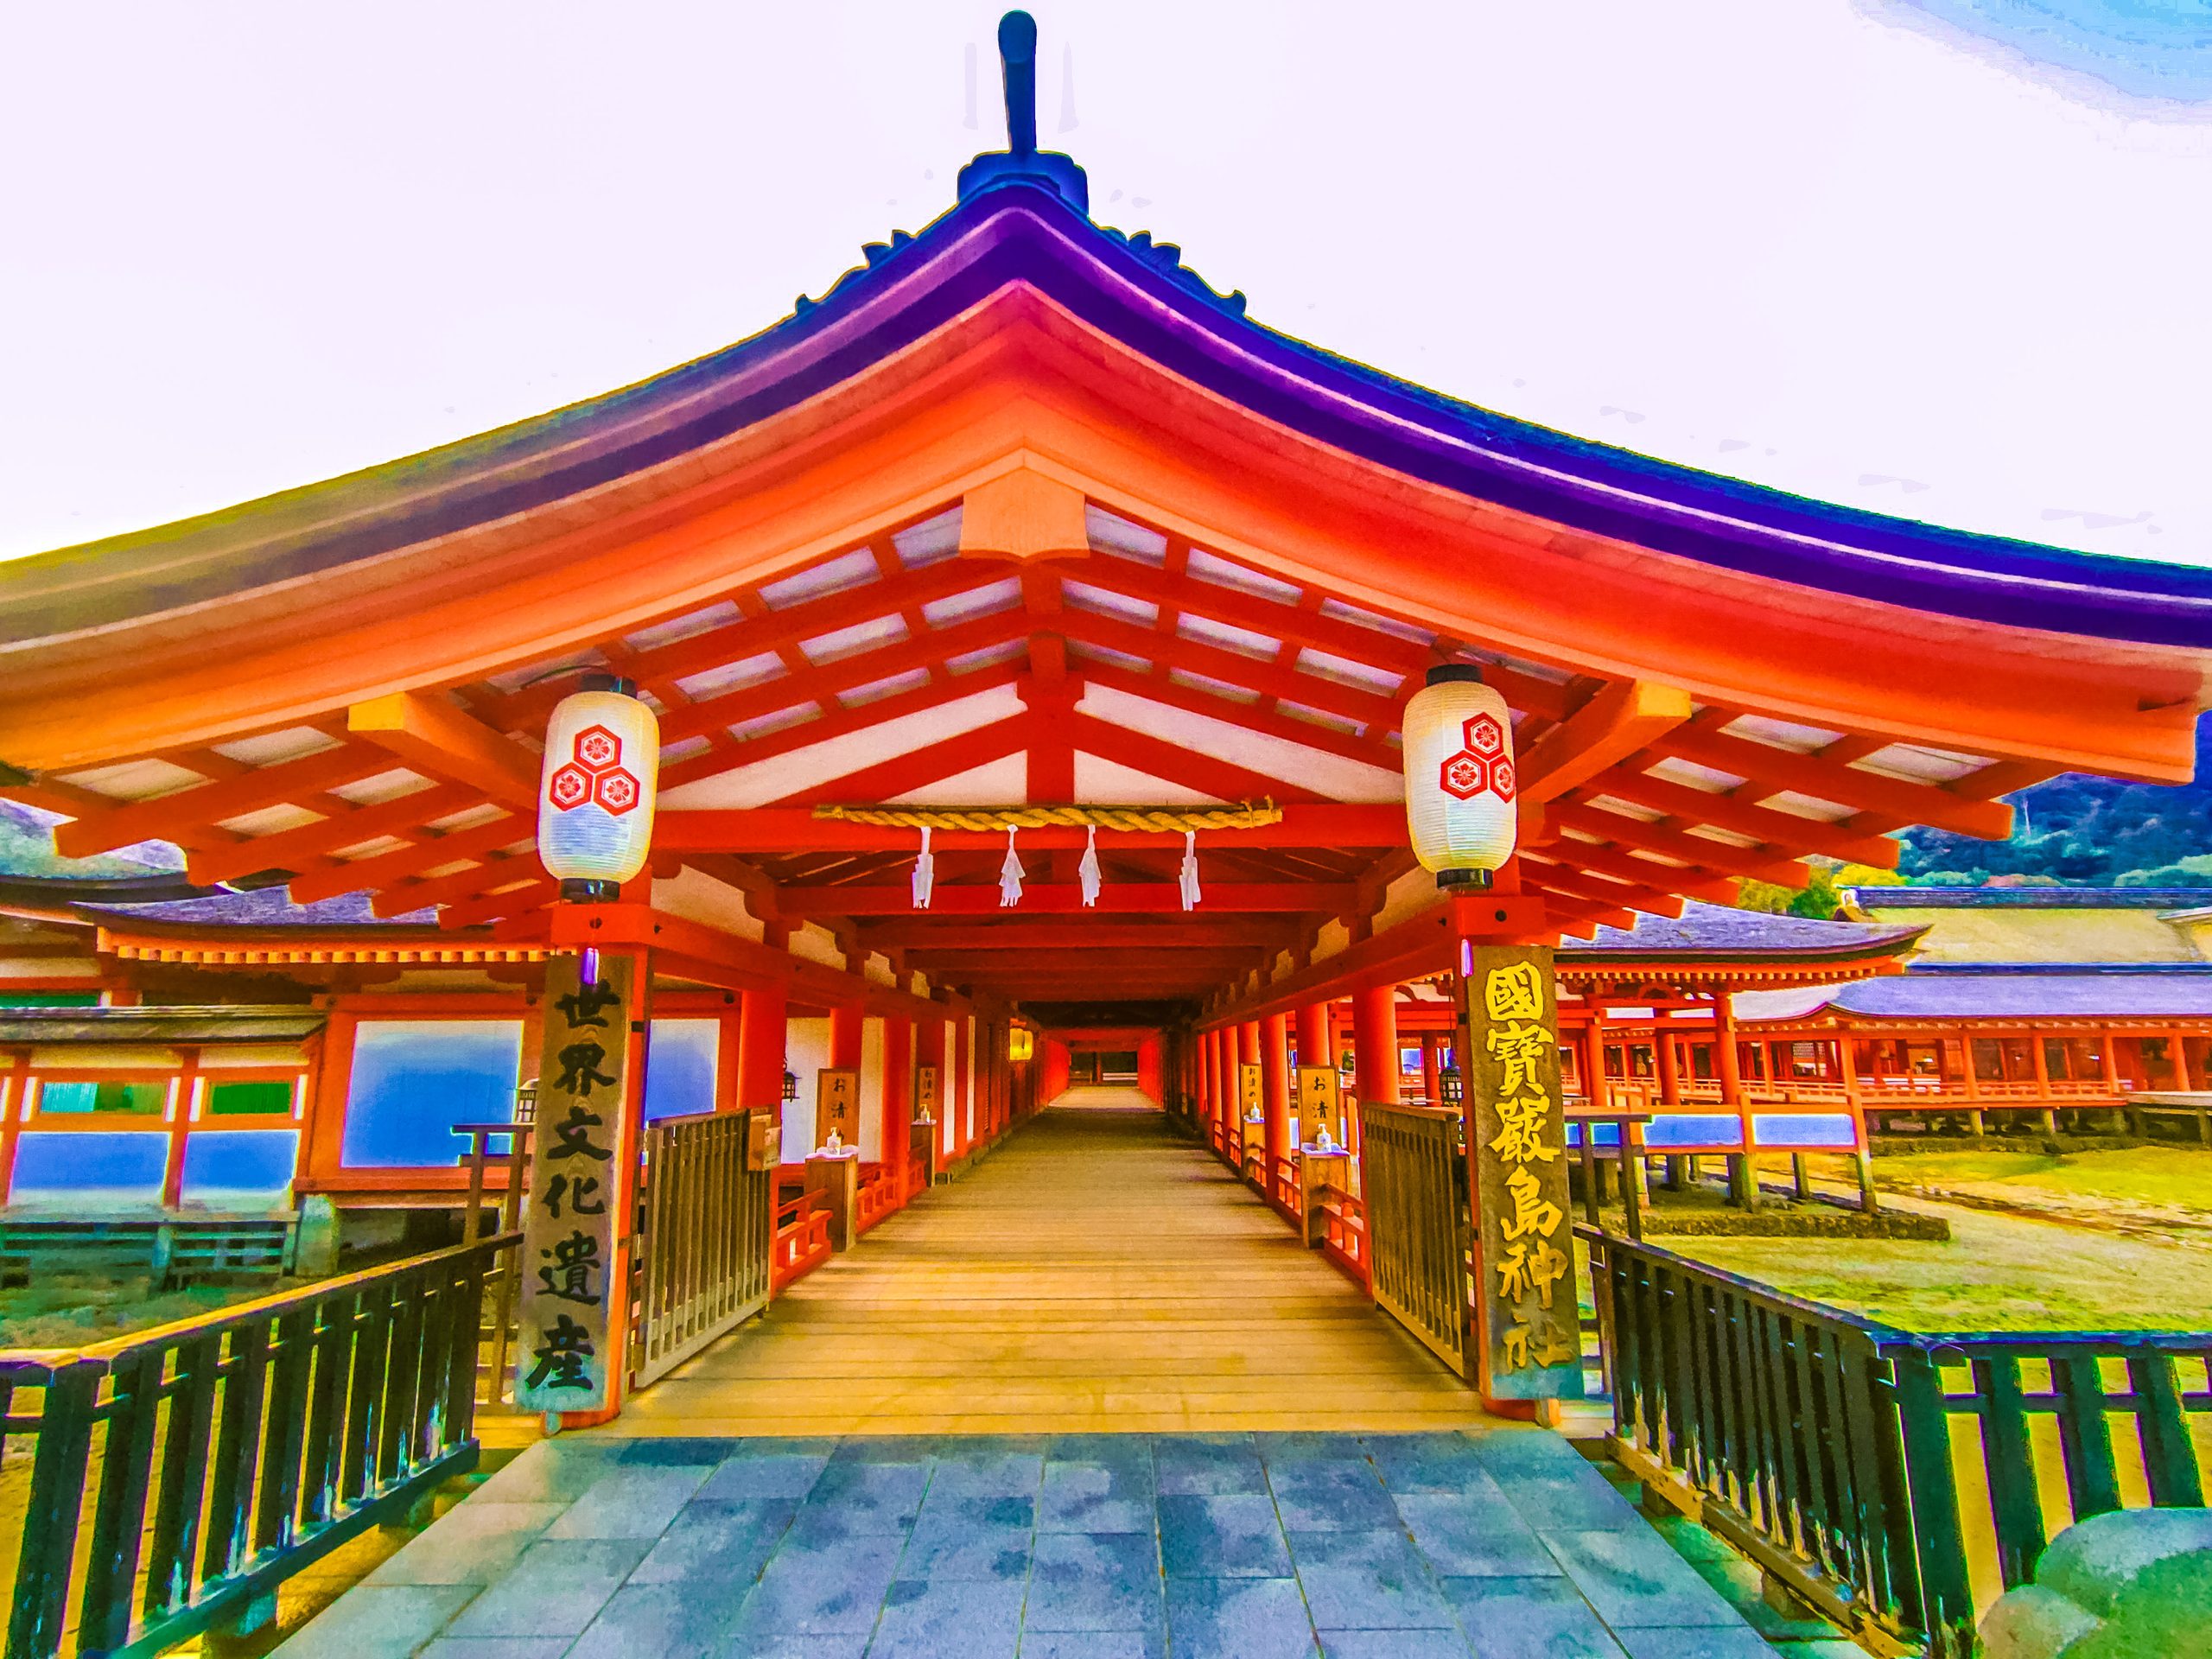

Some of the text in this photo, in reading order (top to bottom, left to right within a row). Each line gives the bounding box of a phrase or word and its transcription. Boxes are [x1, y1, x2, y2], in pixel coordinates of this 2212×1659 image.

[524, 978, 620, 1390] 世界文化遺産
[1312, 1076, 1329, 1119] お清
